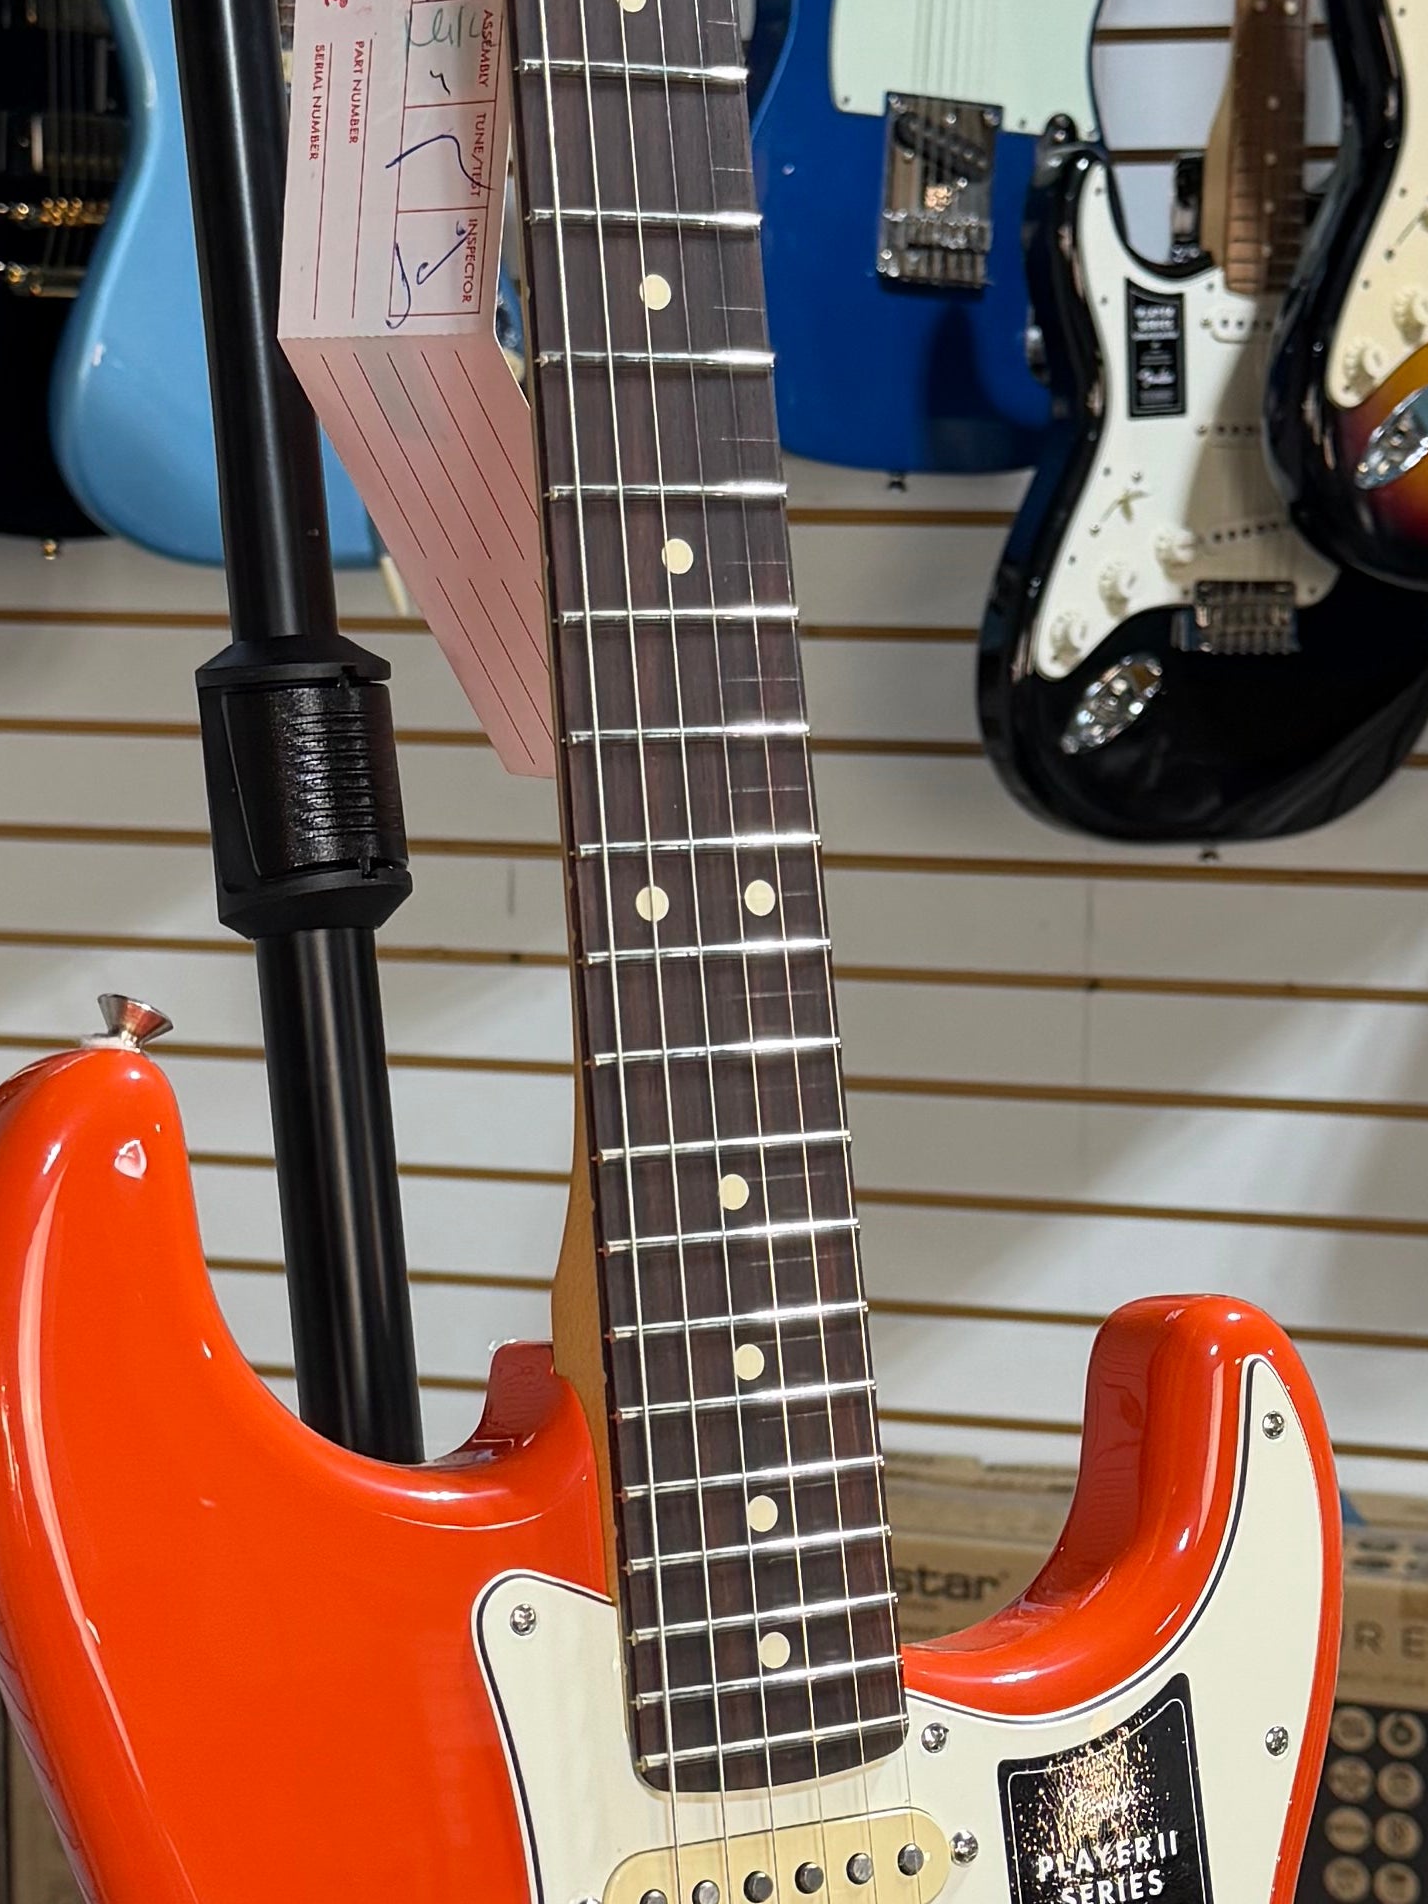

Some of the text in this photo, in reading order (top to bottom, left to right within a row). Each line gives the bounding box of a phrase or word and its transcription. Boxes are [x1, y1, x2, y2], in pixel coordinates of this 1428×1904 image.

[477, 8, 494, 88] ASSEMBLY
[308, 43, 326, 161] SERIAL NUMBER
[348, 39, 366, 145] PART NUMBER
[461, 217, 479, 304] INSPECTOR
[1037, 1829, 1179, 1883] PLAYER II
